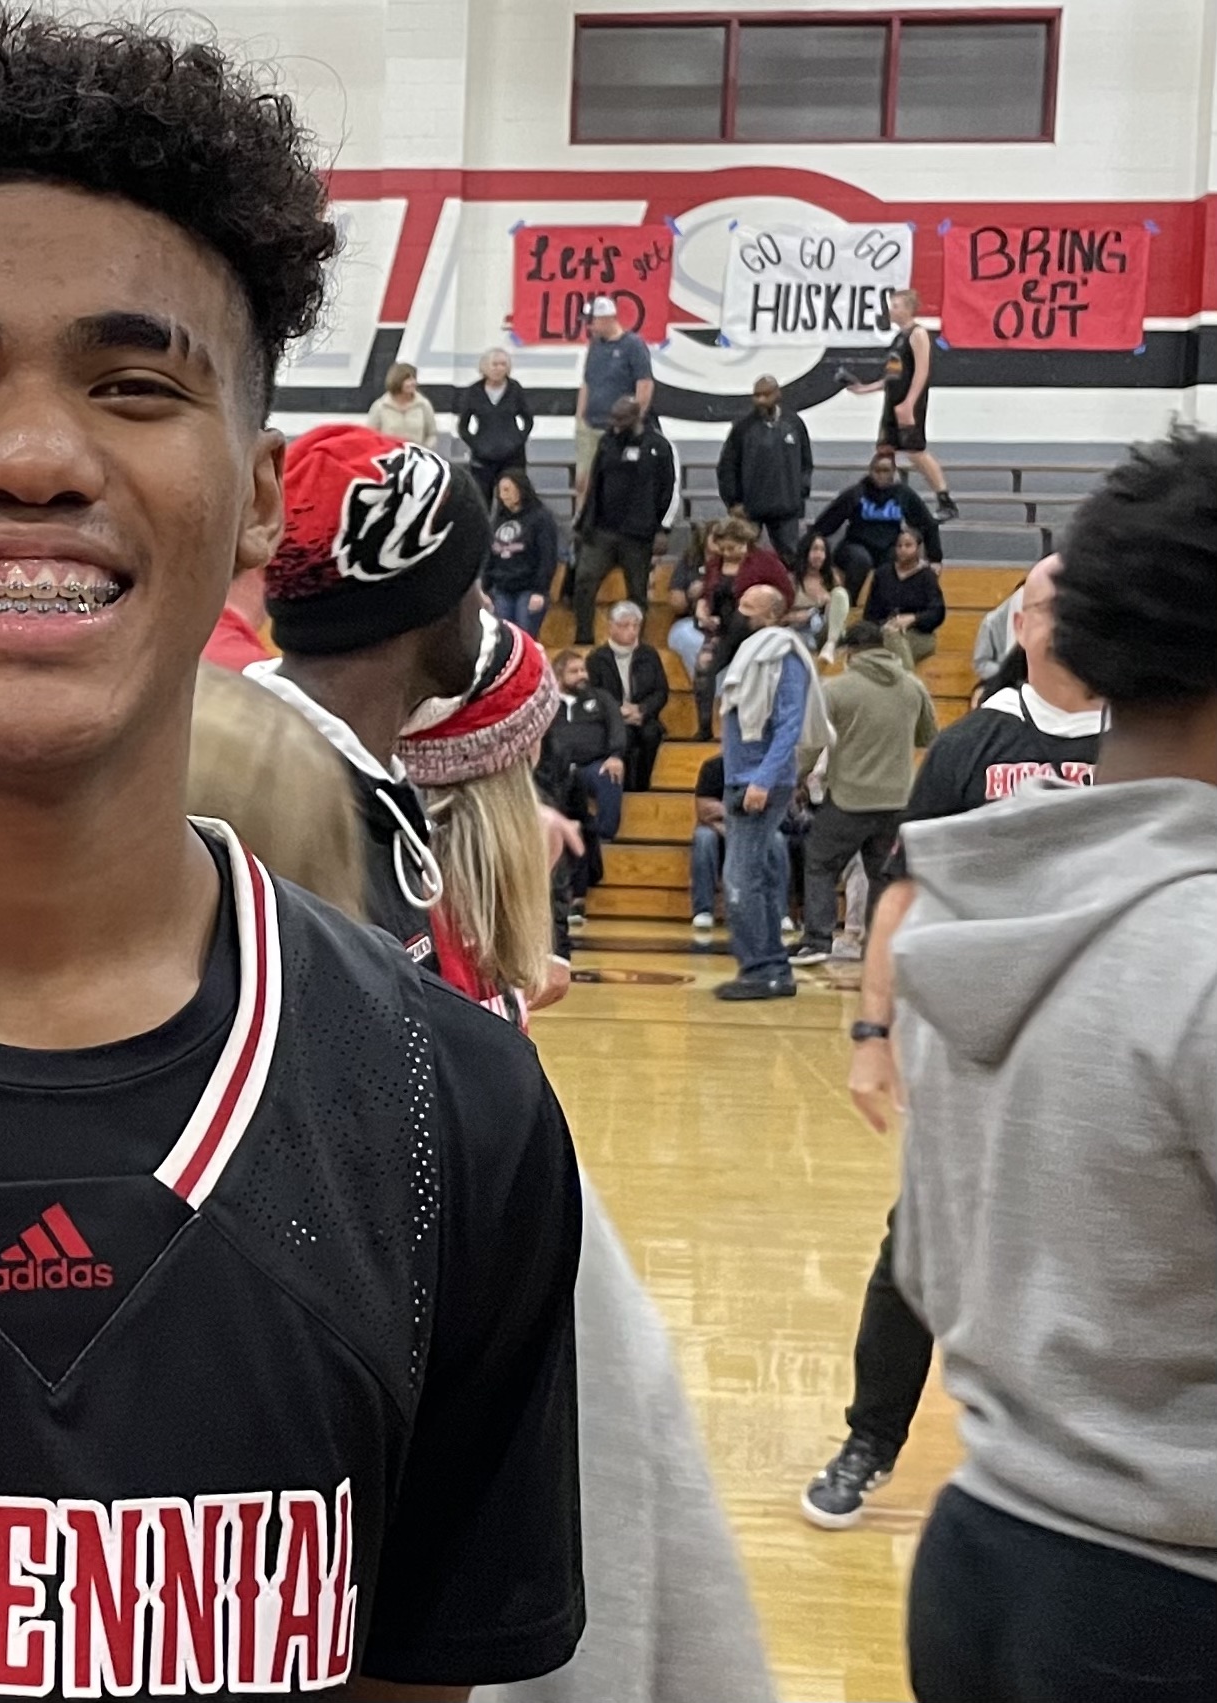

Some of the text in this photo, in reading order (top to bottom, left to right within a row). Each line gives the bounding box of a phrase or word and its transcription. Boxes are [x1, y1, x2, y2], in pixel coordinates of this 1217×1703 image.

[739, 229, 901, 274] GO GO GO
[970, 225, 1127, 281] BRING
[539, 289, 646, 341] LOD
[750, 283, 896, 333] HUSKIES
[993, 300, 1089, 340] OUT
